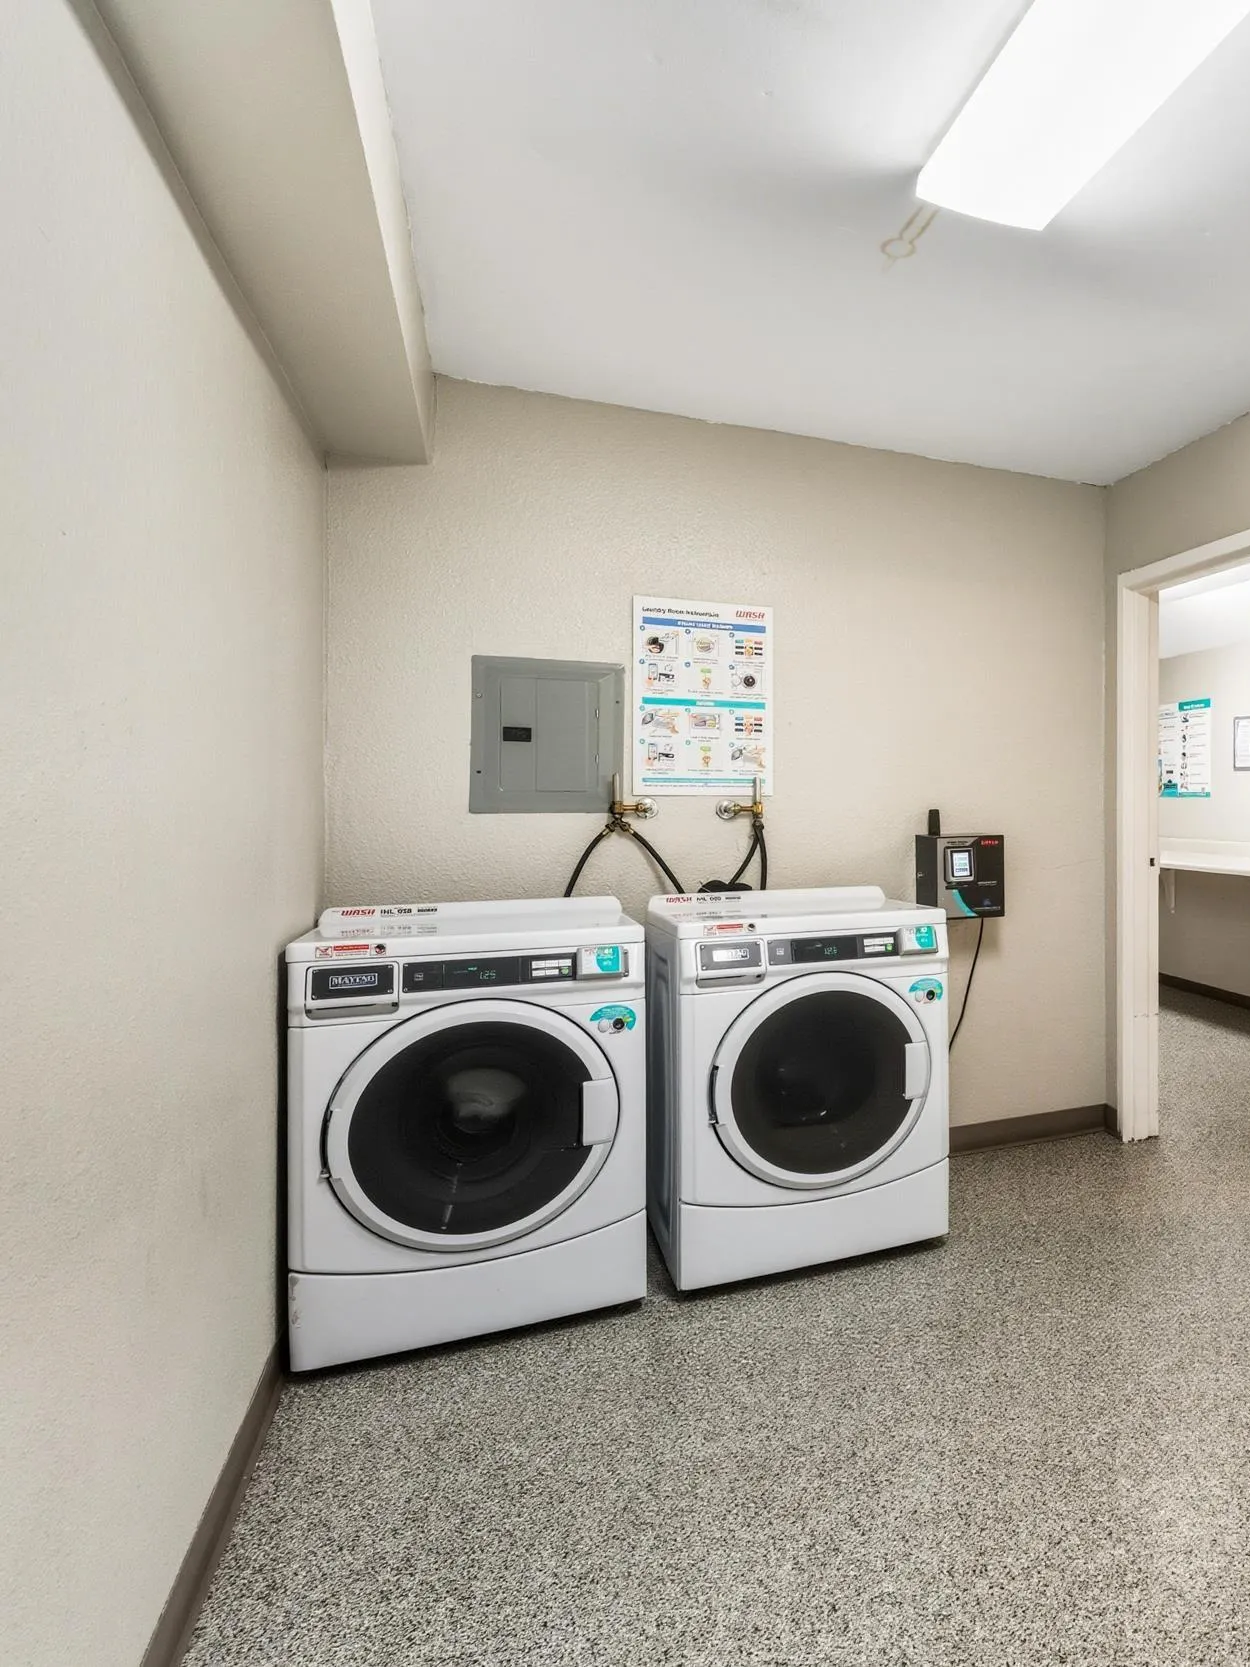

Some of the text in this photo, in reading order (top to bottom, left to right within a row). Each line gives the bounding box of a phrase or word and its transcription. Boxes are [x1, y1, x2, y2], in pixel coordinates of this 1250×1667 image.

[735, 610, 765, 619] WASH
[341, 908, 376, 917] WASH
[332, 975, 375, 985] MAYTAG
